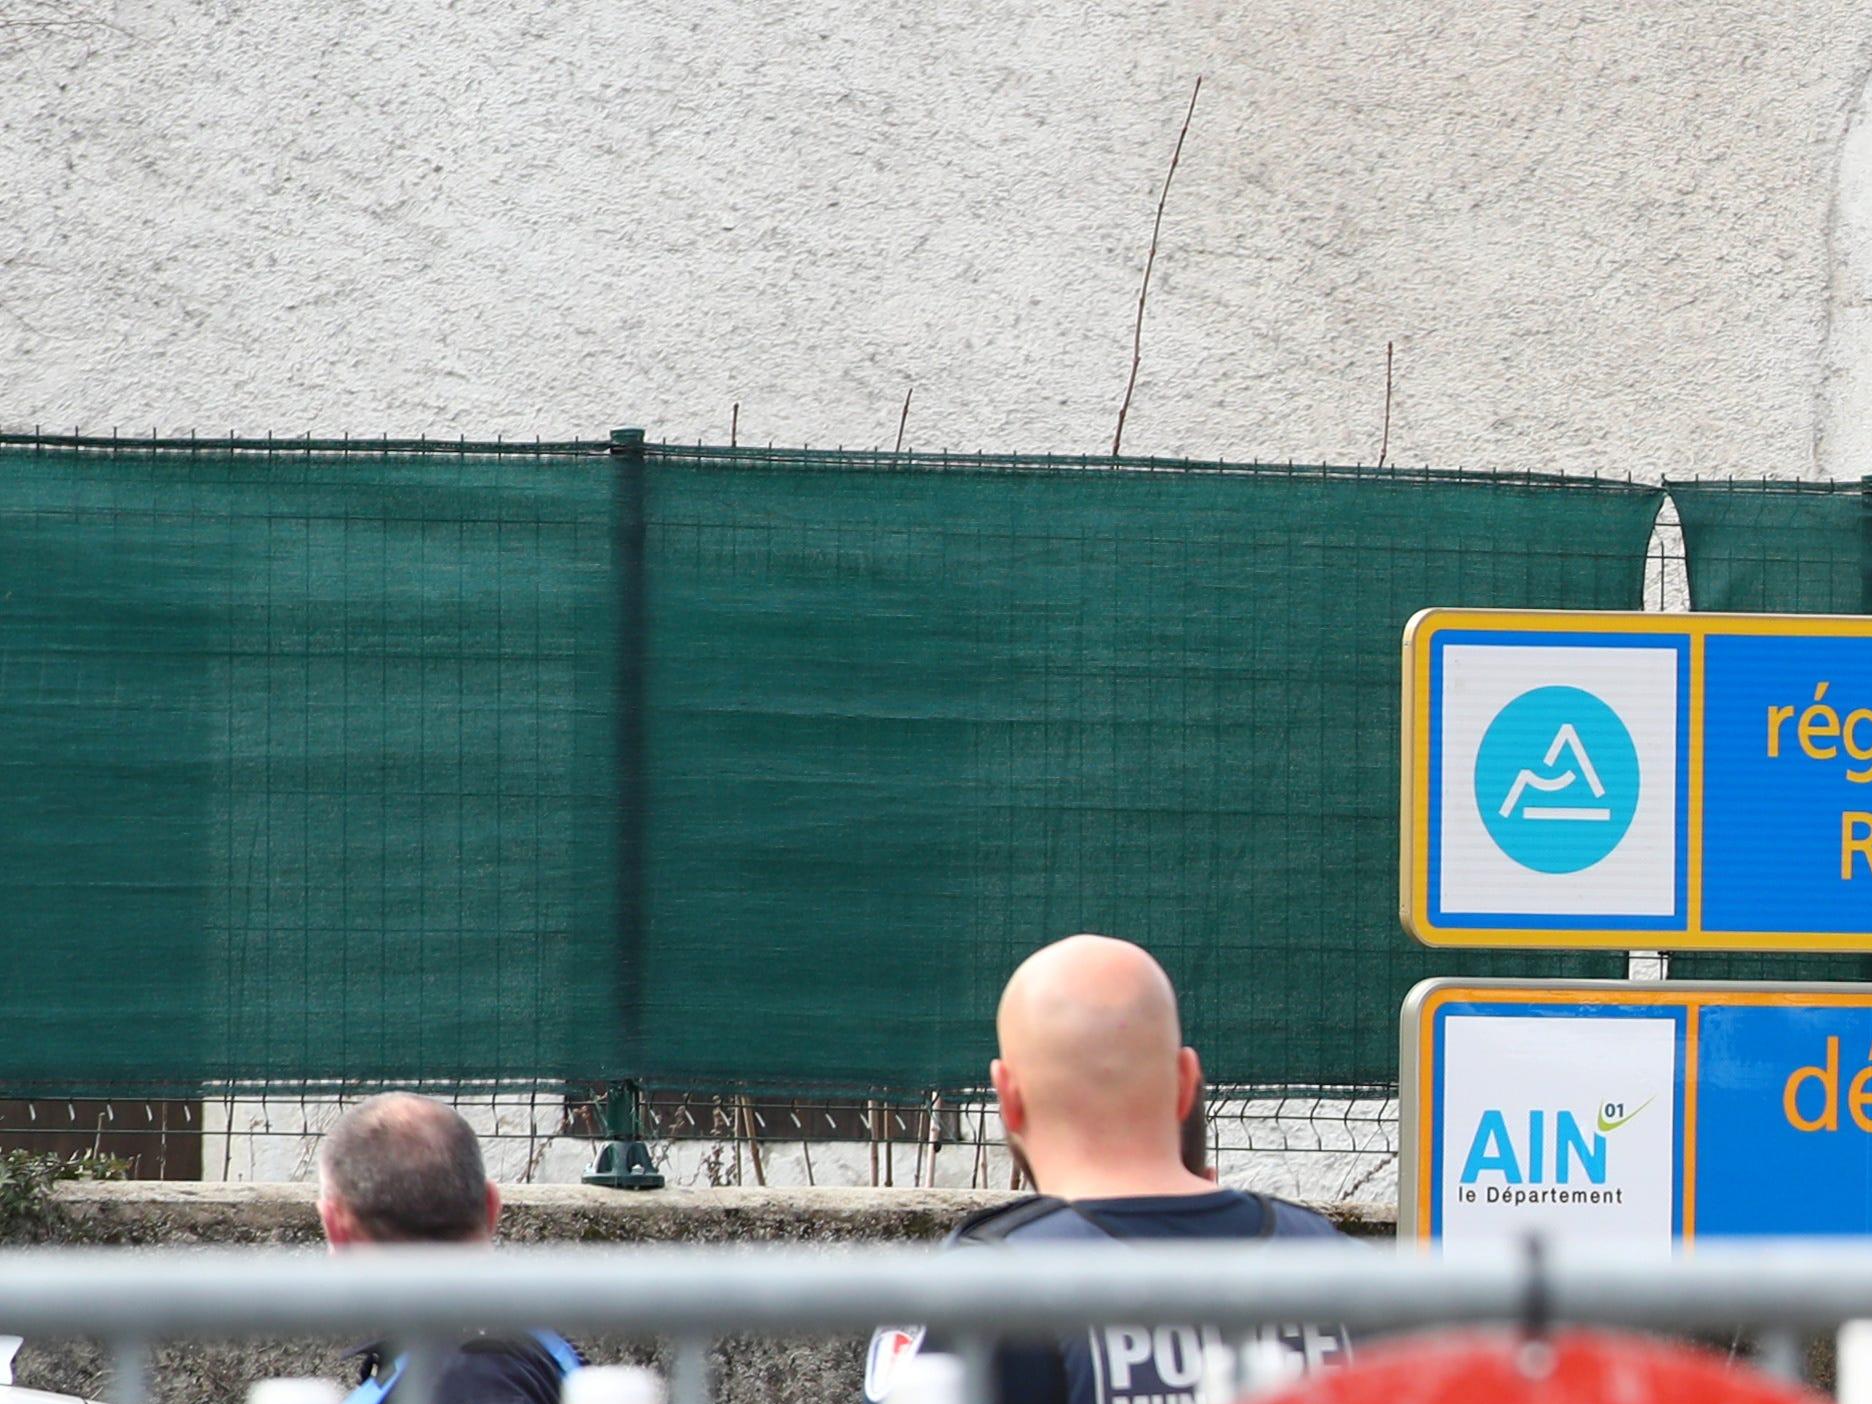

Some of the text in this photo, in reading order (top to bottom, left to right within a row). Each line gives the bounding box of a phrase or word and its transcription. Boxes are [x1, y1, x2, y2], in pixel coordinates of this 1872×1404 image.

[1605, 1103, 1624, 1118] 01
[1460, 1109, 1607, 1184] AIN
[1459, 1186, 1622, 1206] le Département
[1104, 1322, 1341, 1390] POCE
